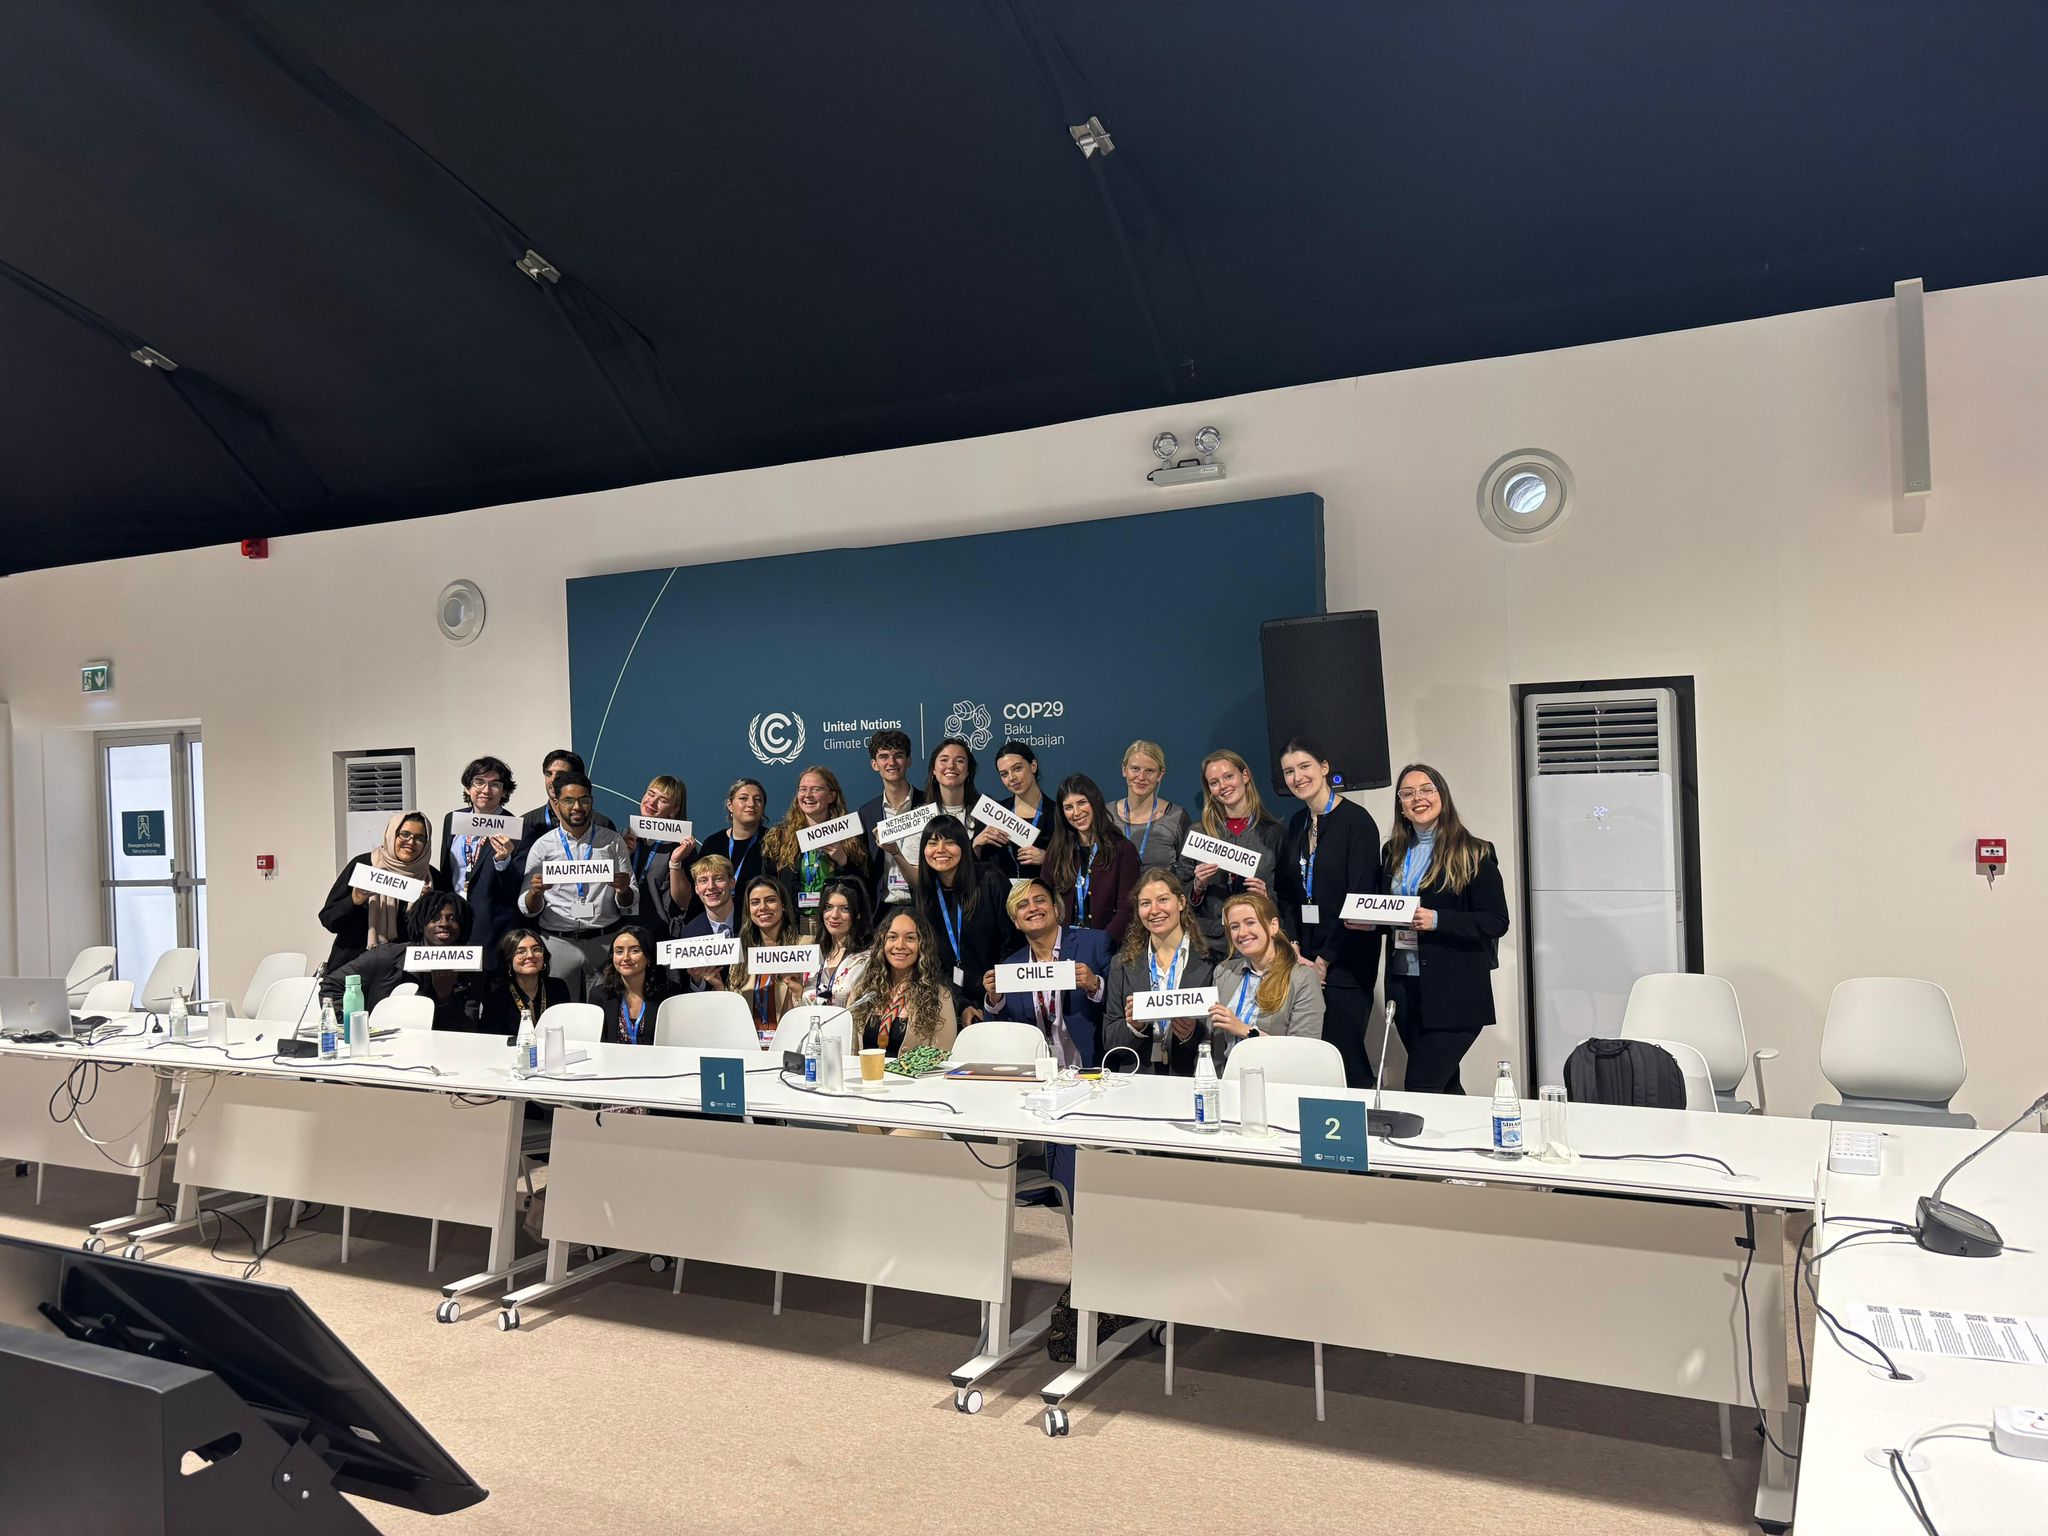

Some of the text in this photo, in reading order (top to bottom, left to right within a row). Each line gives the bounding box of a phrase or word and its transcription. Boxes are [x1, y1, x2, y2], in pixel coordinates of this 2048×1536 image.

[1003, 701, 1063, 719] COP29
[823, 718, 901, 732] United Nations
[1004, 723, 1032, 735] Baku
[823, 738, 861, 750] Climate
[471, 817, 505, 830] SPAIN
[885, 807, 930, 828] NETHERLANDS
[982, 803, 1031, 839] SLOVENIA
[639, 820, 682, 833] ESTONIA
[807, 819, 850, 841] NORWAY
[881, 822, 912, 839] (KINGDOM
[912, 818, 922, 827] OF
[1188, 834, 1257, 867] LUXEMBOURG
[545, 863, 610, 875] MAURITANIA
[369, 871, 409, 890] YEMEN
[1355, 897, 1405, 911] POLAND
[413, 950, 474, 961] BAHAMAS
[675, 943, 735, 958] PARAGUAY
[756, 950, 812, 963] HUNGARY
[1016, 965, 1054, 980] CHILE
[1146, 992, 1204, 1008] AUSTRIA
[718, 1072, 725, 1090] 1
[1325, 1117, 1342, 1140] 2
